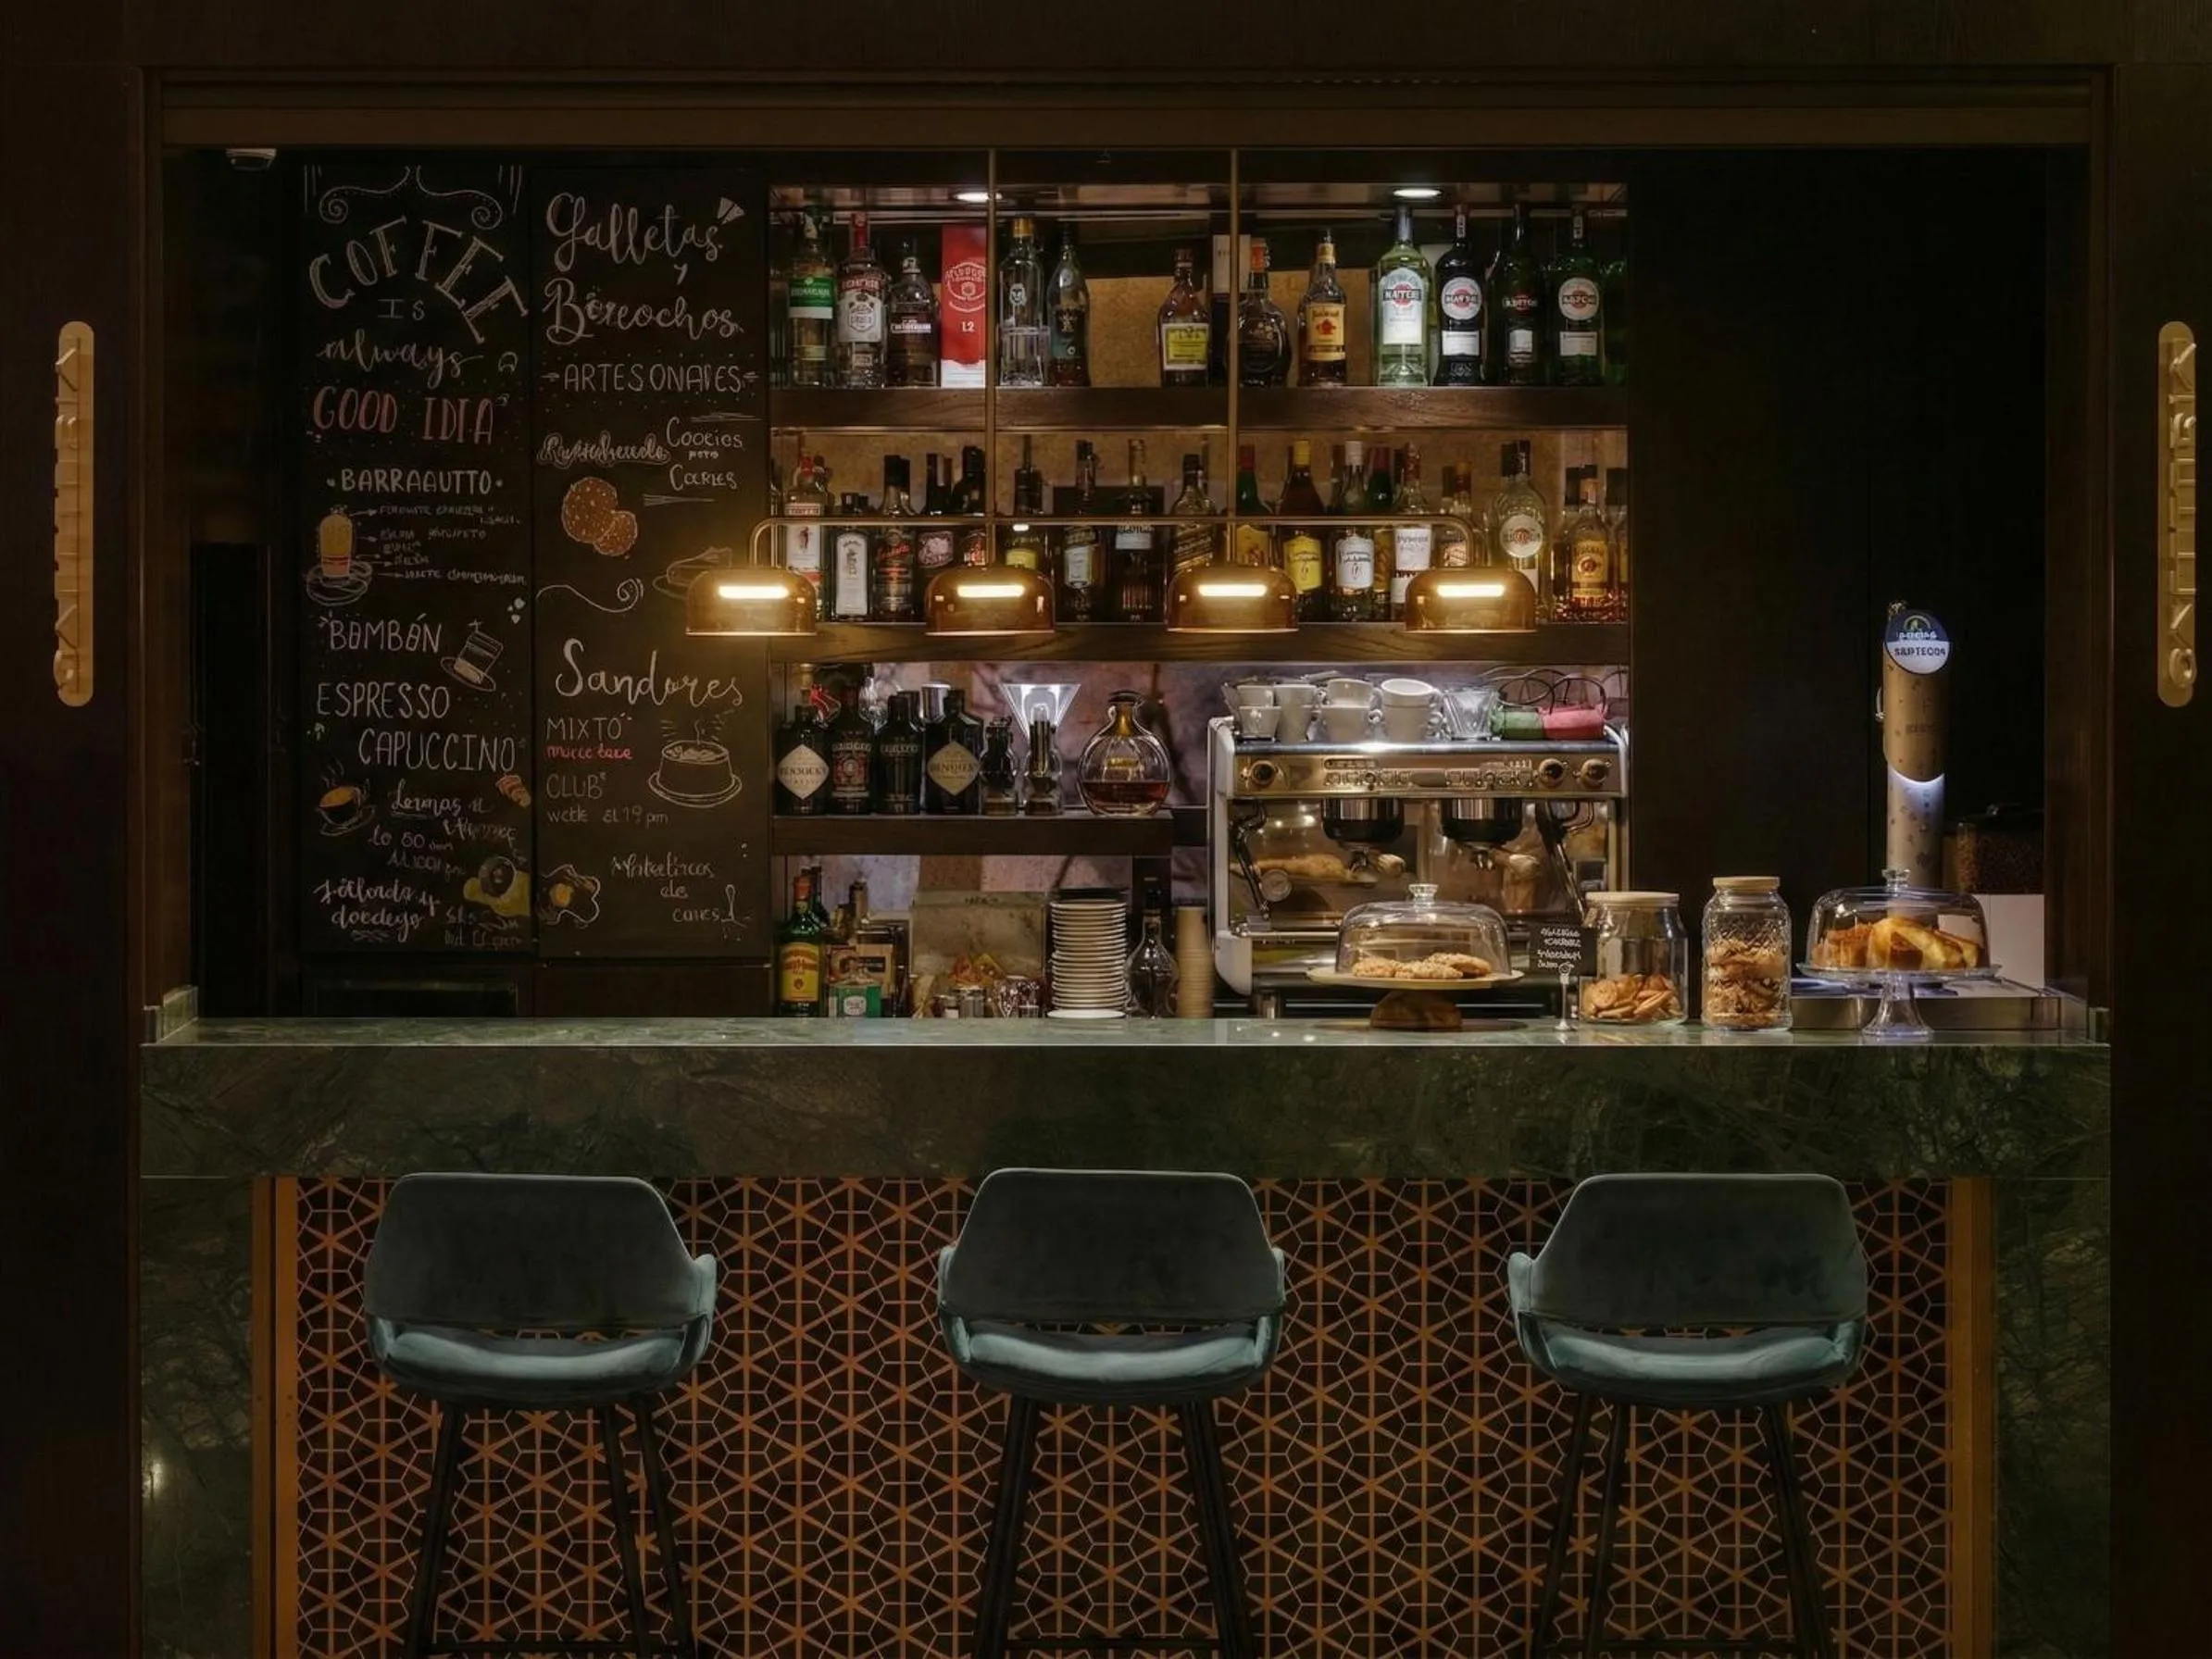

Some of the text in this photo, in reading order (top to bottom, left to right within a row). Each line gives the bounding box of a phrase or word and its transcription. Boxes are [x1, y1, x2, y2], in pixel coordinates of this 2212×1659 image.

[378, 298, 425, 321] IS
[313, 385, 398, 433] GOOD
[316, 680, 451, 719] ESPRESSO
[357, 727, 517, 773] CAPUCCINO
